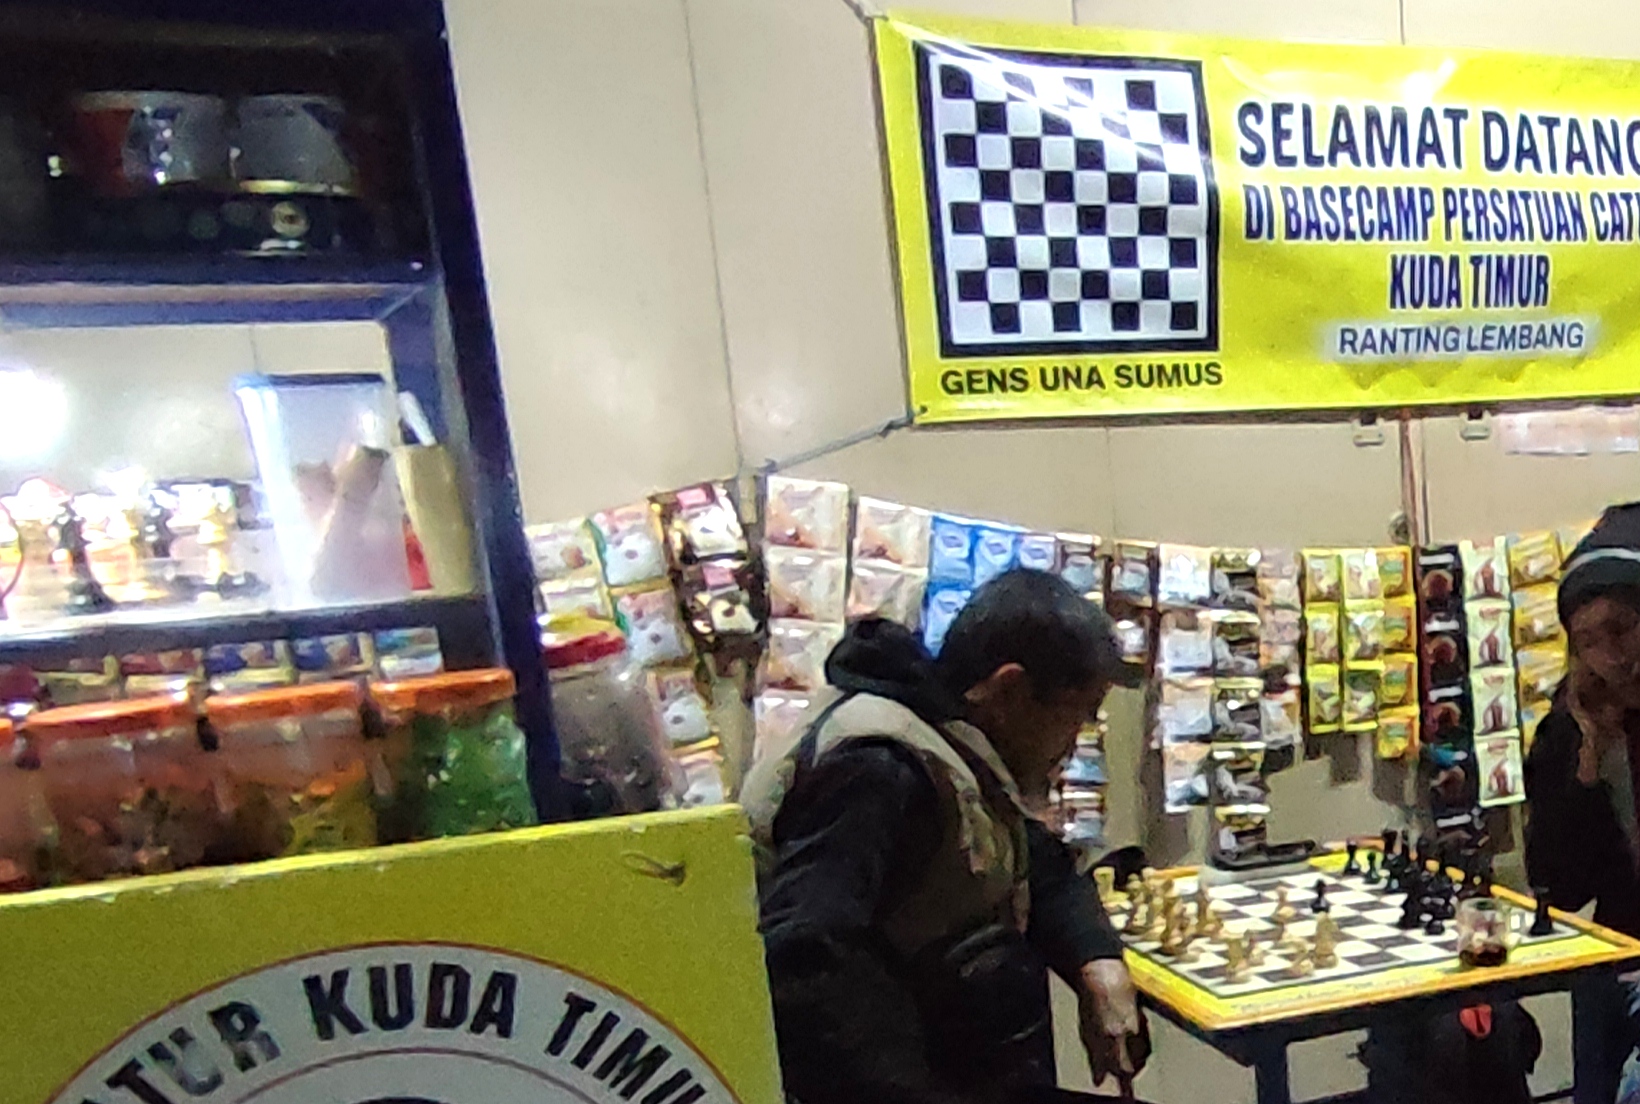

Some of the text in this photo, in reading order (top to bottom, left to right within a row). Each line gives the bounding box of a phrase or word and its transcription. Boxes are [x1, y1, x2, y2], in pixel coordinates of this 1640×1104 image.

[1238, 102, 1468, 168] SELAMAT
[1243, 184, 1274, 240] DI
[1285, 185, 1434, 241] BASECAMP
[1444, 188, 1587, 241] PERSATUAN
[1389, 254, 1549, 309] KUDA TIMUR
[1339, 322, 1584, 354] RANTING LEMBANG
[940, 362, 1224, 395] GENS UNA SUMUS
[303, 962, 518, 1042] KUDA
